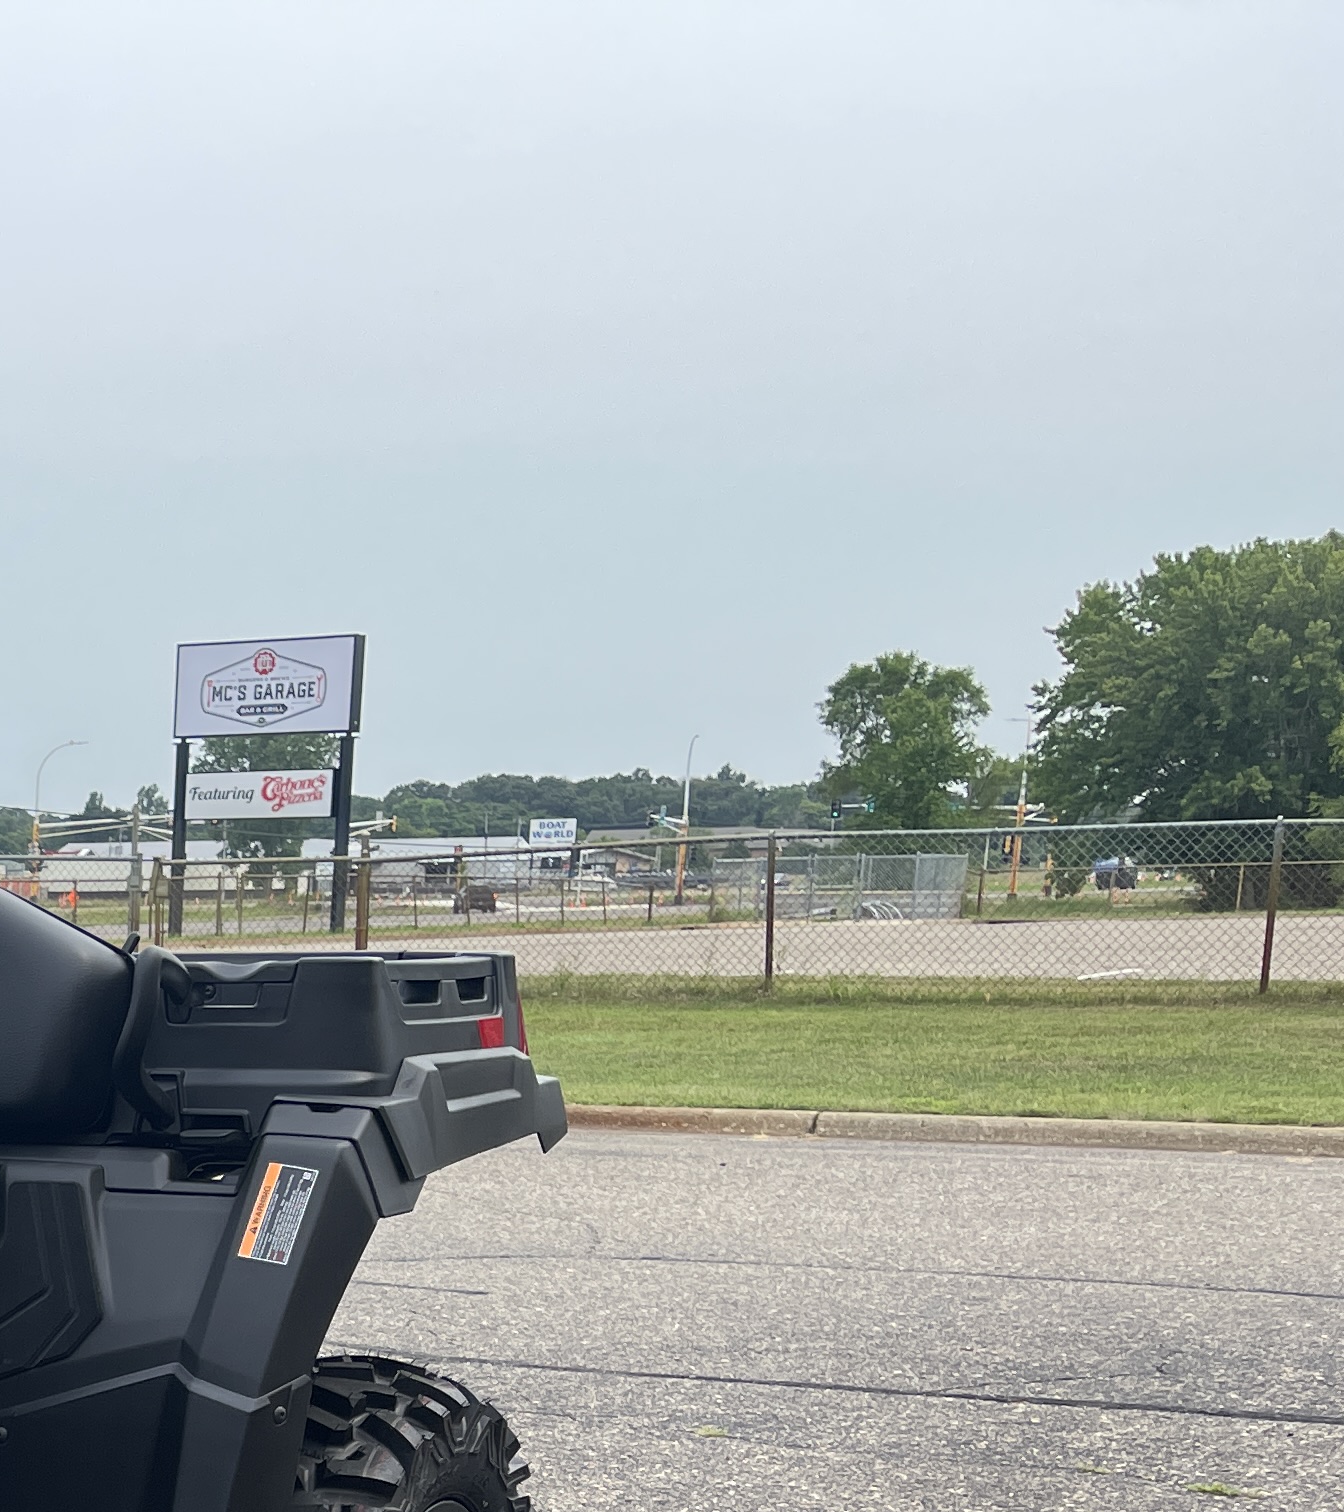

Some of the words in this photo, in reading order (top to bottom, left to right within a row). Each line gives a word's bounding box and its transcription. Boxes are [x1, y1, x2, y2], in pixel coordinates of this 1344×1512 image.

[212, 685, 246, 702] MC'S
[254, 682, 315, 700] GARAGE
[262, 705, 284, 713] GRILL
[189, 787, 254, 803] Featuring
[539, 821, 568, 829] BOAT
[252, 1185, 272, 1225] WARNING
